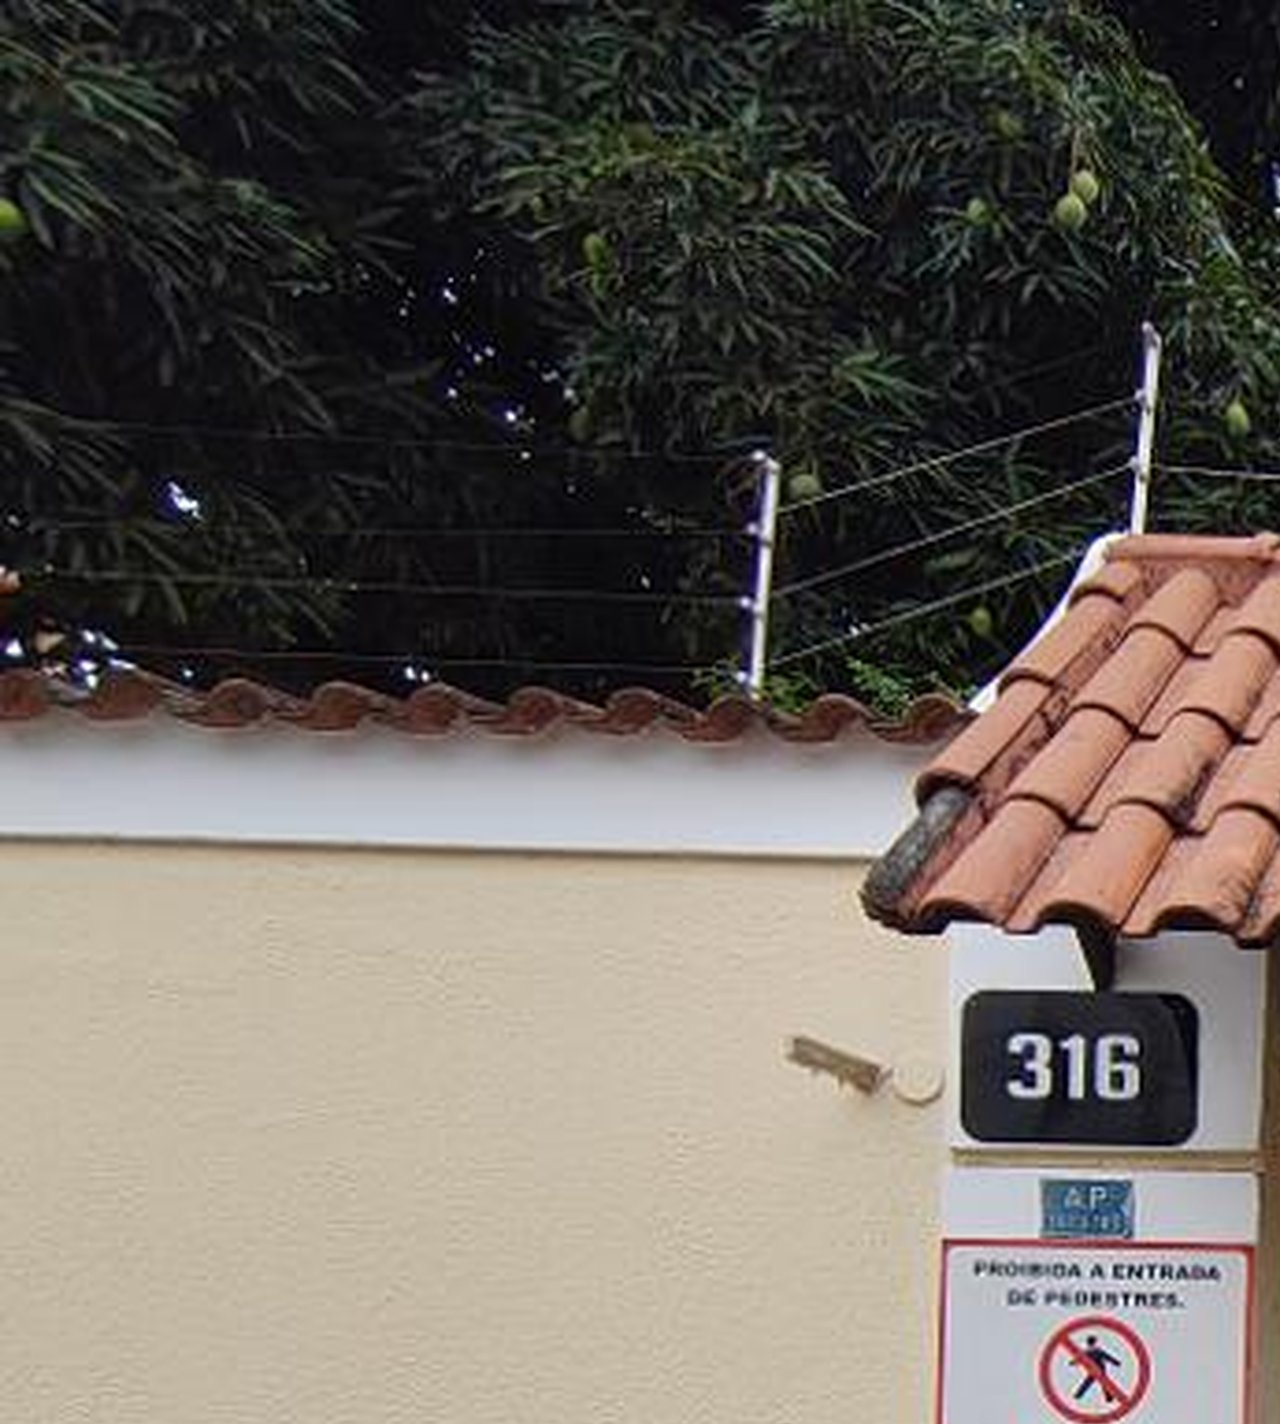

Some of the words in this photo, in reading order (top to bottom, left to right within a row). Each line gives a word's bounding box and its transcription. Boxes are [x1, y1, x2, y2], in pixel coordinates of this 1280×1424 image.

[1006, 1032, 1141, 1100] 316
[973, 1260, 1082, 1280] PROIBIDA
[1090, 1262, 1106, 1280] A
[1112, 1263, 1222, 1281] ENTRADA
[1007, 1289, 1037, 1306] DE
